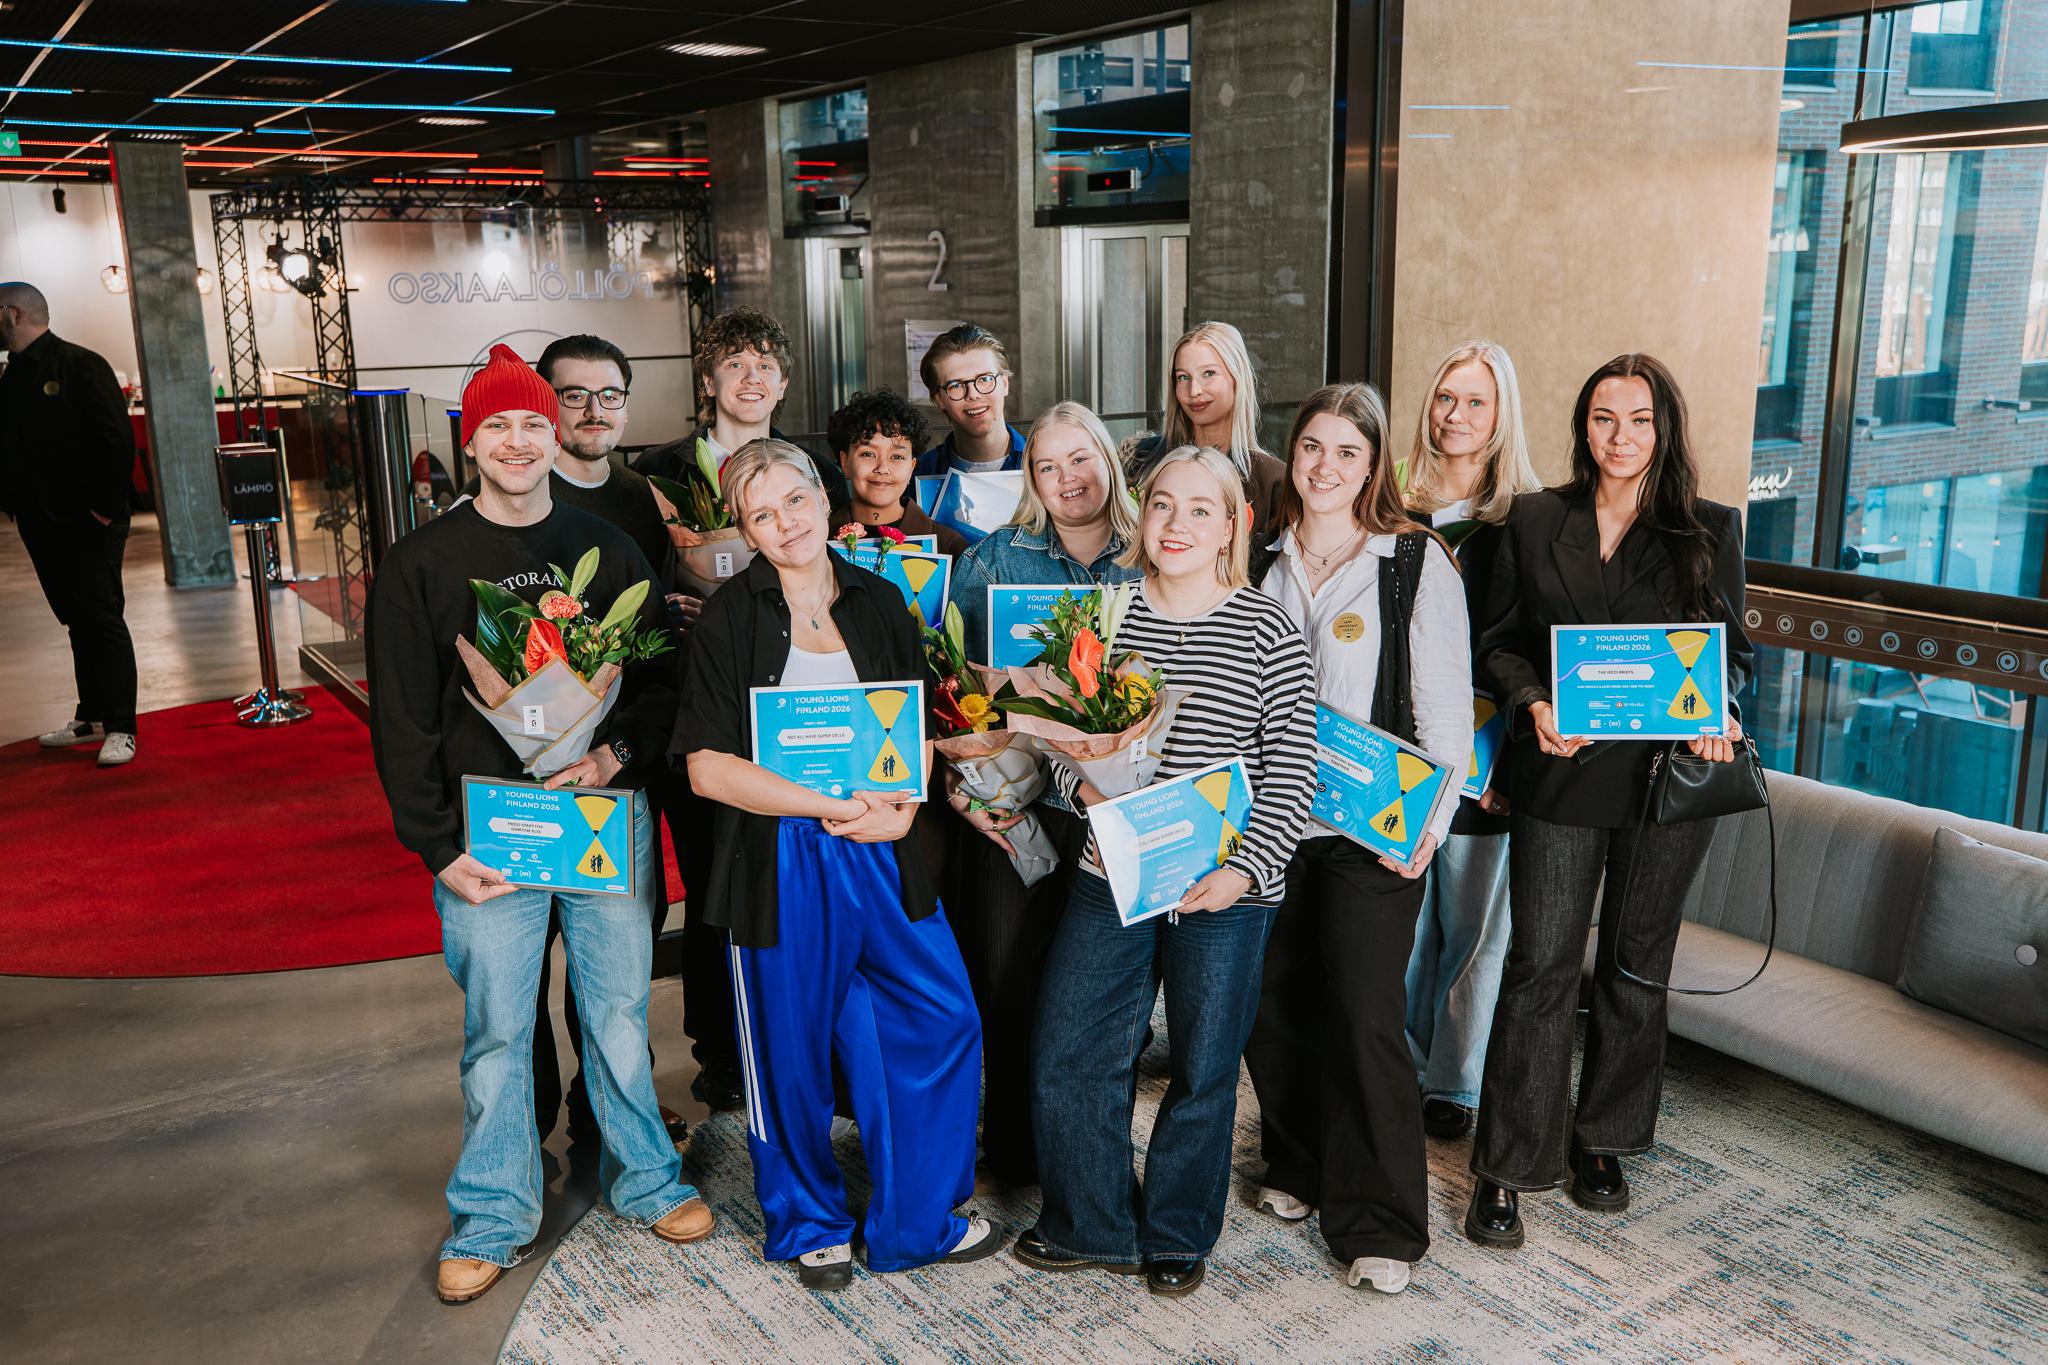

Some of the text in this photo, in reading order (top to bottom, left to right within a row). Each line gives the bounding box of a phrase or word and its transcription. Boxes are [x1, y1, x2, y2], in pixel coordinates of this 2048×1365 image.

[928, 230, 948, 291] 2
[234, 482, 274, 494] LÄMPIÖ
[1027, 594, 1054, 602] YOUNG
[1595, 634, 1650, 642] YOUNG LIONS
[1631, 643, 1651, 651] 2026
[794, 695, 849, 704] YOUNG LIONS
[795, 704, 851, 714] FINLAND 2026
[1337, 721, 1362, 738] YOUNG
[1362, 735, 1384, 750] LIONS
[1333, 730, 1363, 749] FINLAND
[1363, 745, 1381, 759] 2026
[504, 790, 559, 802] YOUNG LIONS
[1130, 789, 1180, 811] YOUNG LIONS
[506, 799, 560, 811] FINLAND 2026
[1134, 799, 1184, 821] FINLAND 2026
